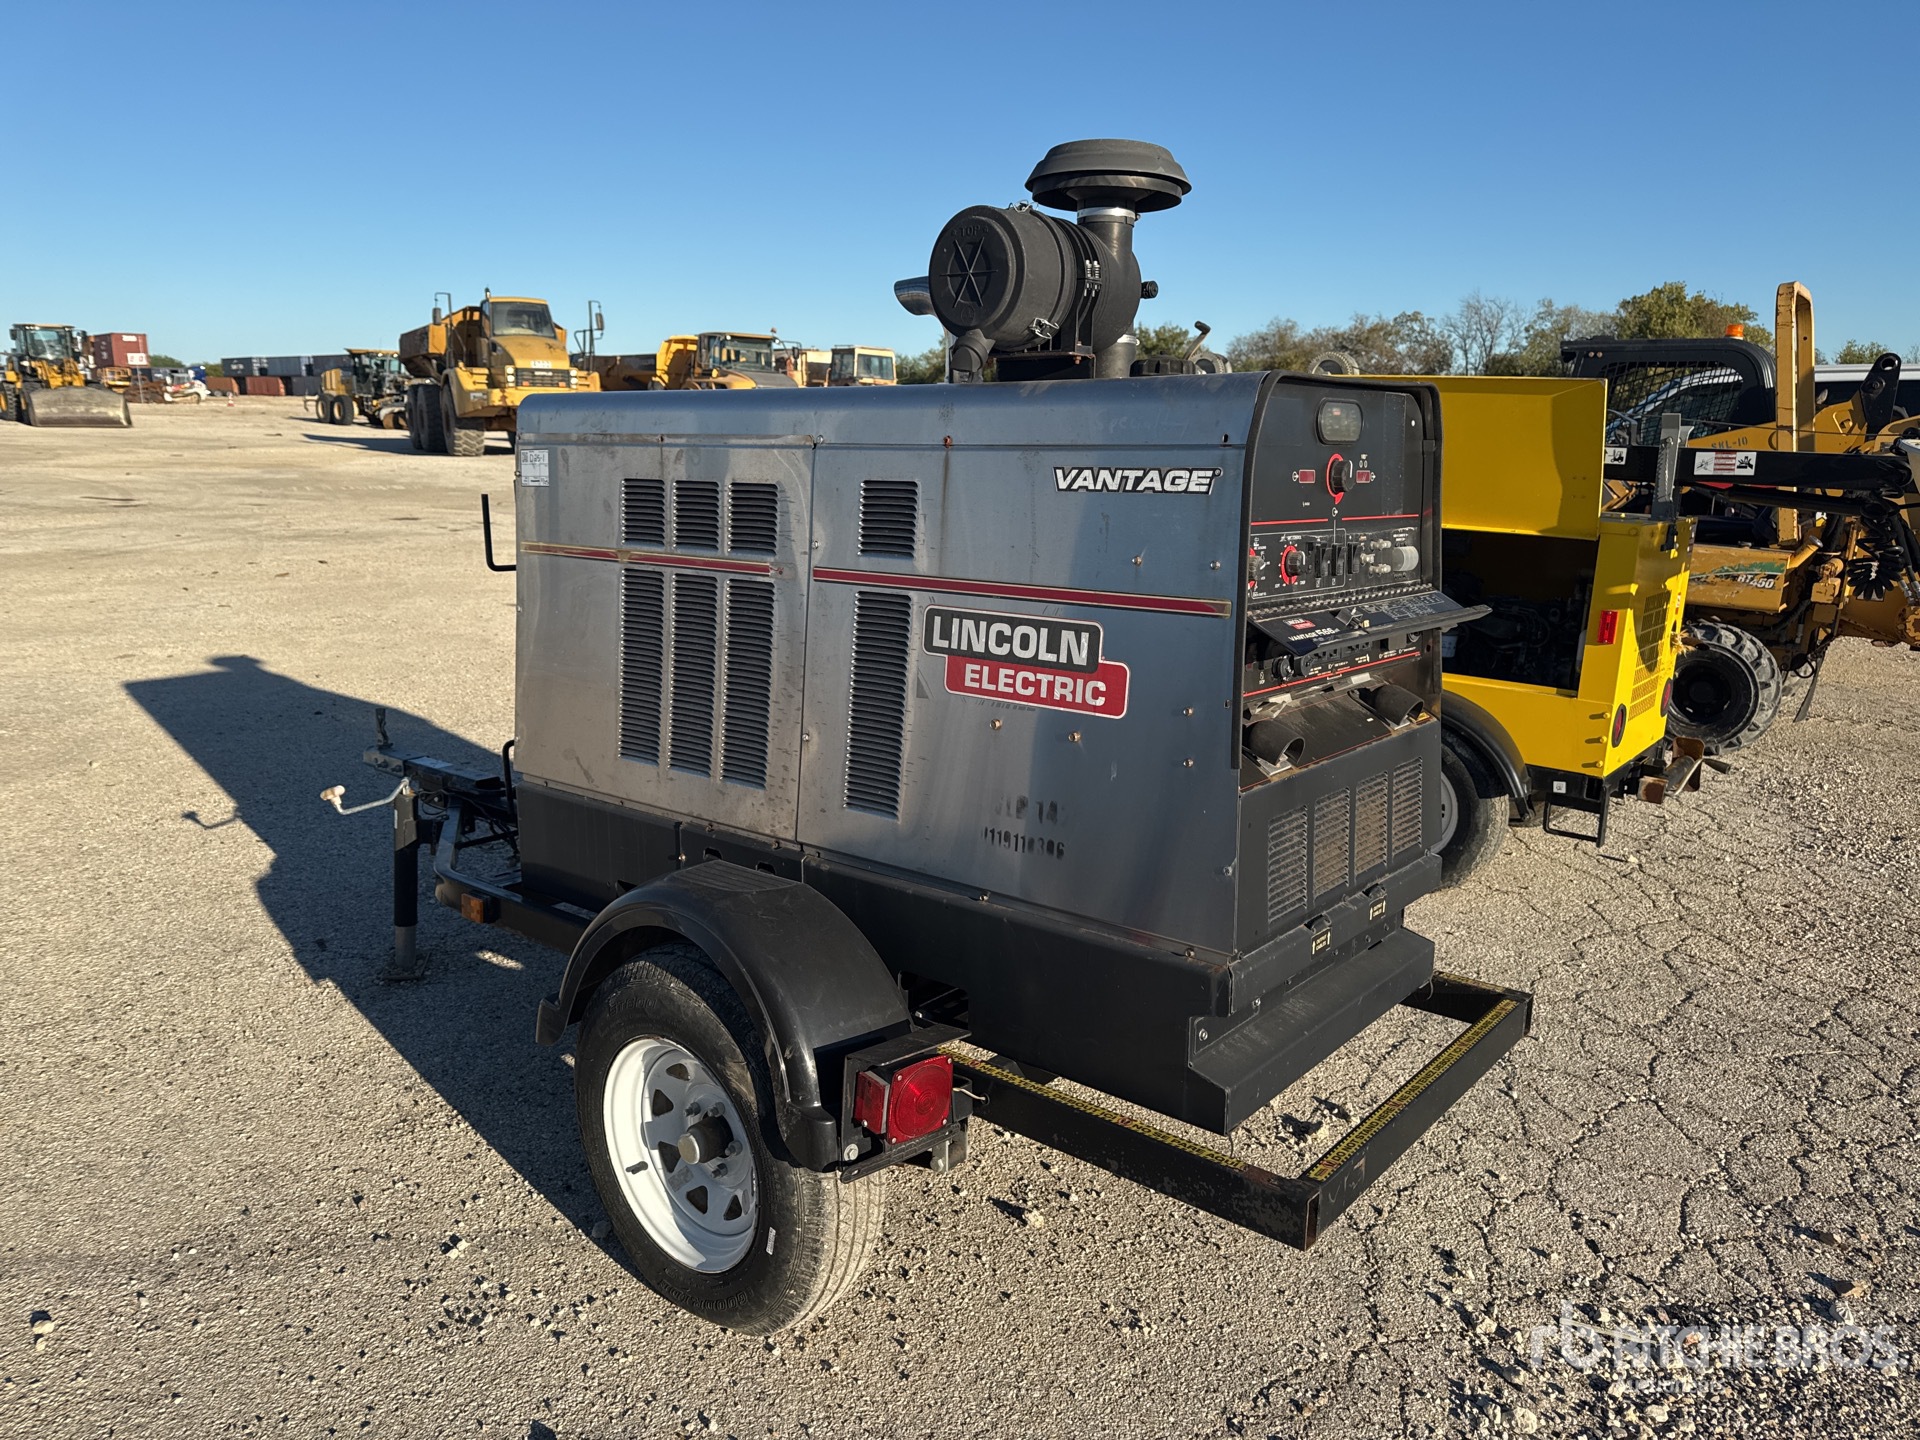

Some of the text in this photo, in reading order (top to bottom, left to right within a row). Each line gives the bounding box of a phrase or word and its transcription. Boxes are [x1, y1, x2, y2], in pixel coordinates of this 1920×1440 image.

[1055, 469, 1214, 492] VANTAGE
[932, 615, 1090, 666] LINCOLN
[964, 663, 1107, 707] ELECTRIC
[1133, 1123, 1151, 1133] NO
[1332, 1150, 1346, 1161] DO
[1343, 1139, 1360, 1152] NOT
[1356, 1119, 1379, 1141] STAND
[1378, 1106, 1395, 1122] HERE
